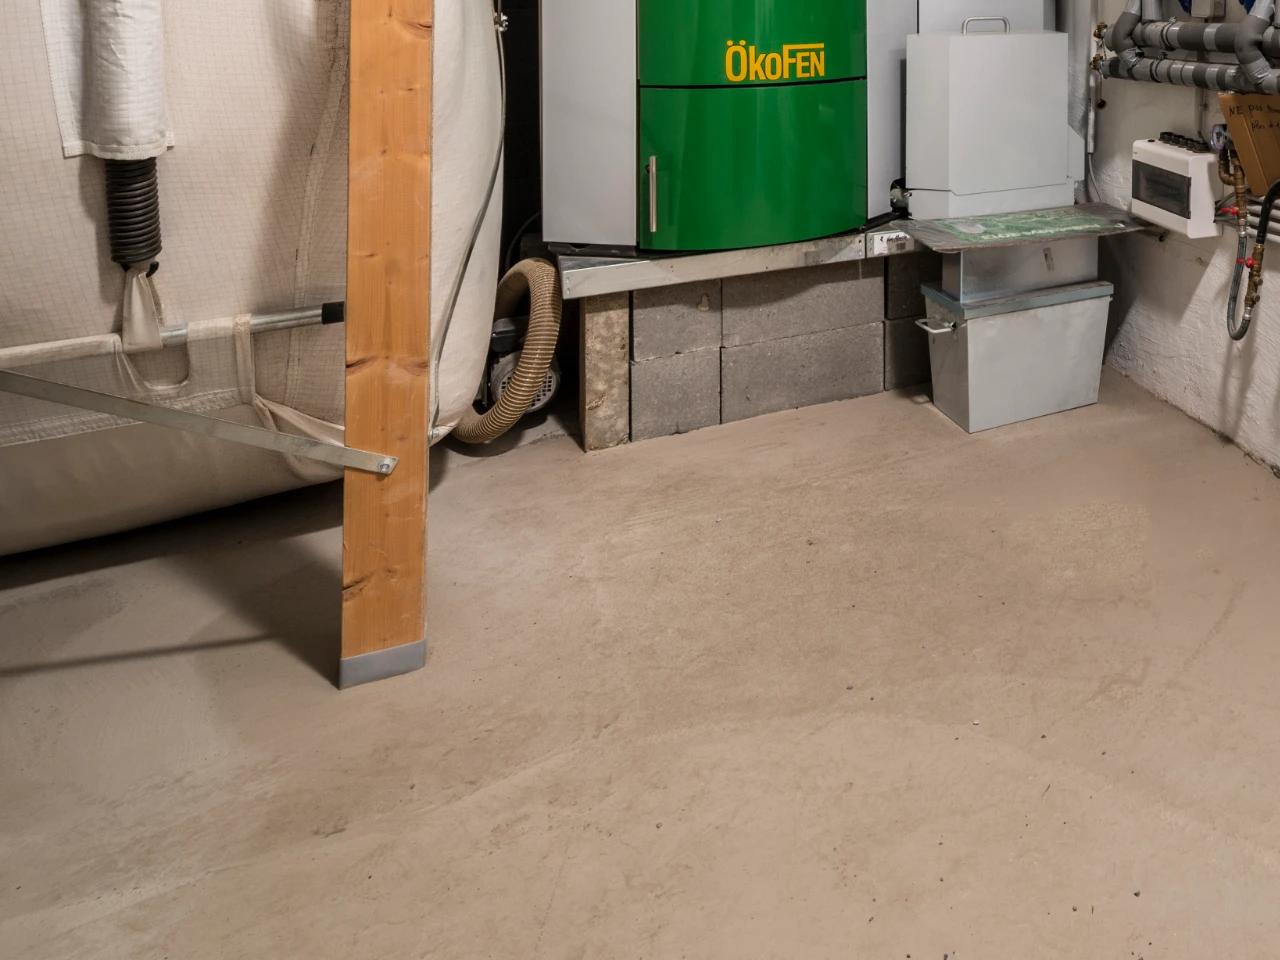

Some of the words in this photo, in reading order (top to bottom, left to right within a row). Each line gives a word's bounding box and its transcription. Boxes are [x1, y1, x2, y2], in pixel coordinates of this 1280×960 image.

[725, 39, 825, 82] ÖkoFEN
[1229, 105, 1243, 117] NE
[1248, 104, 1263, 118] pas
